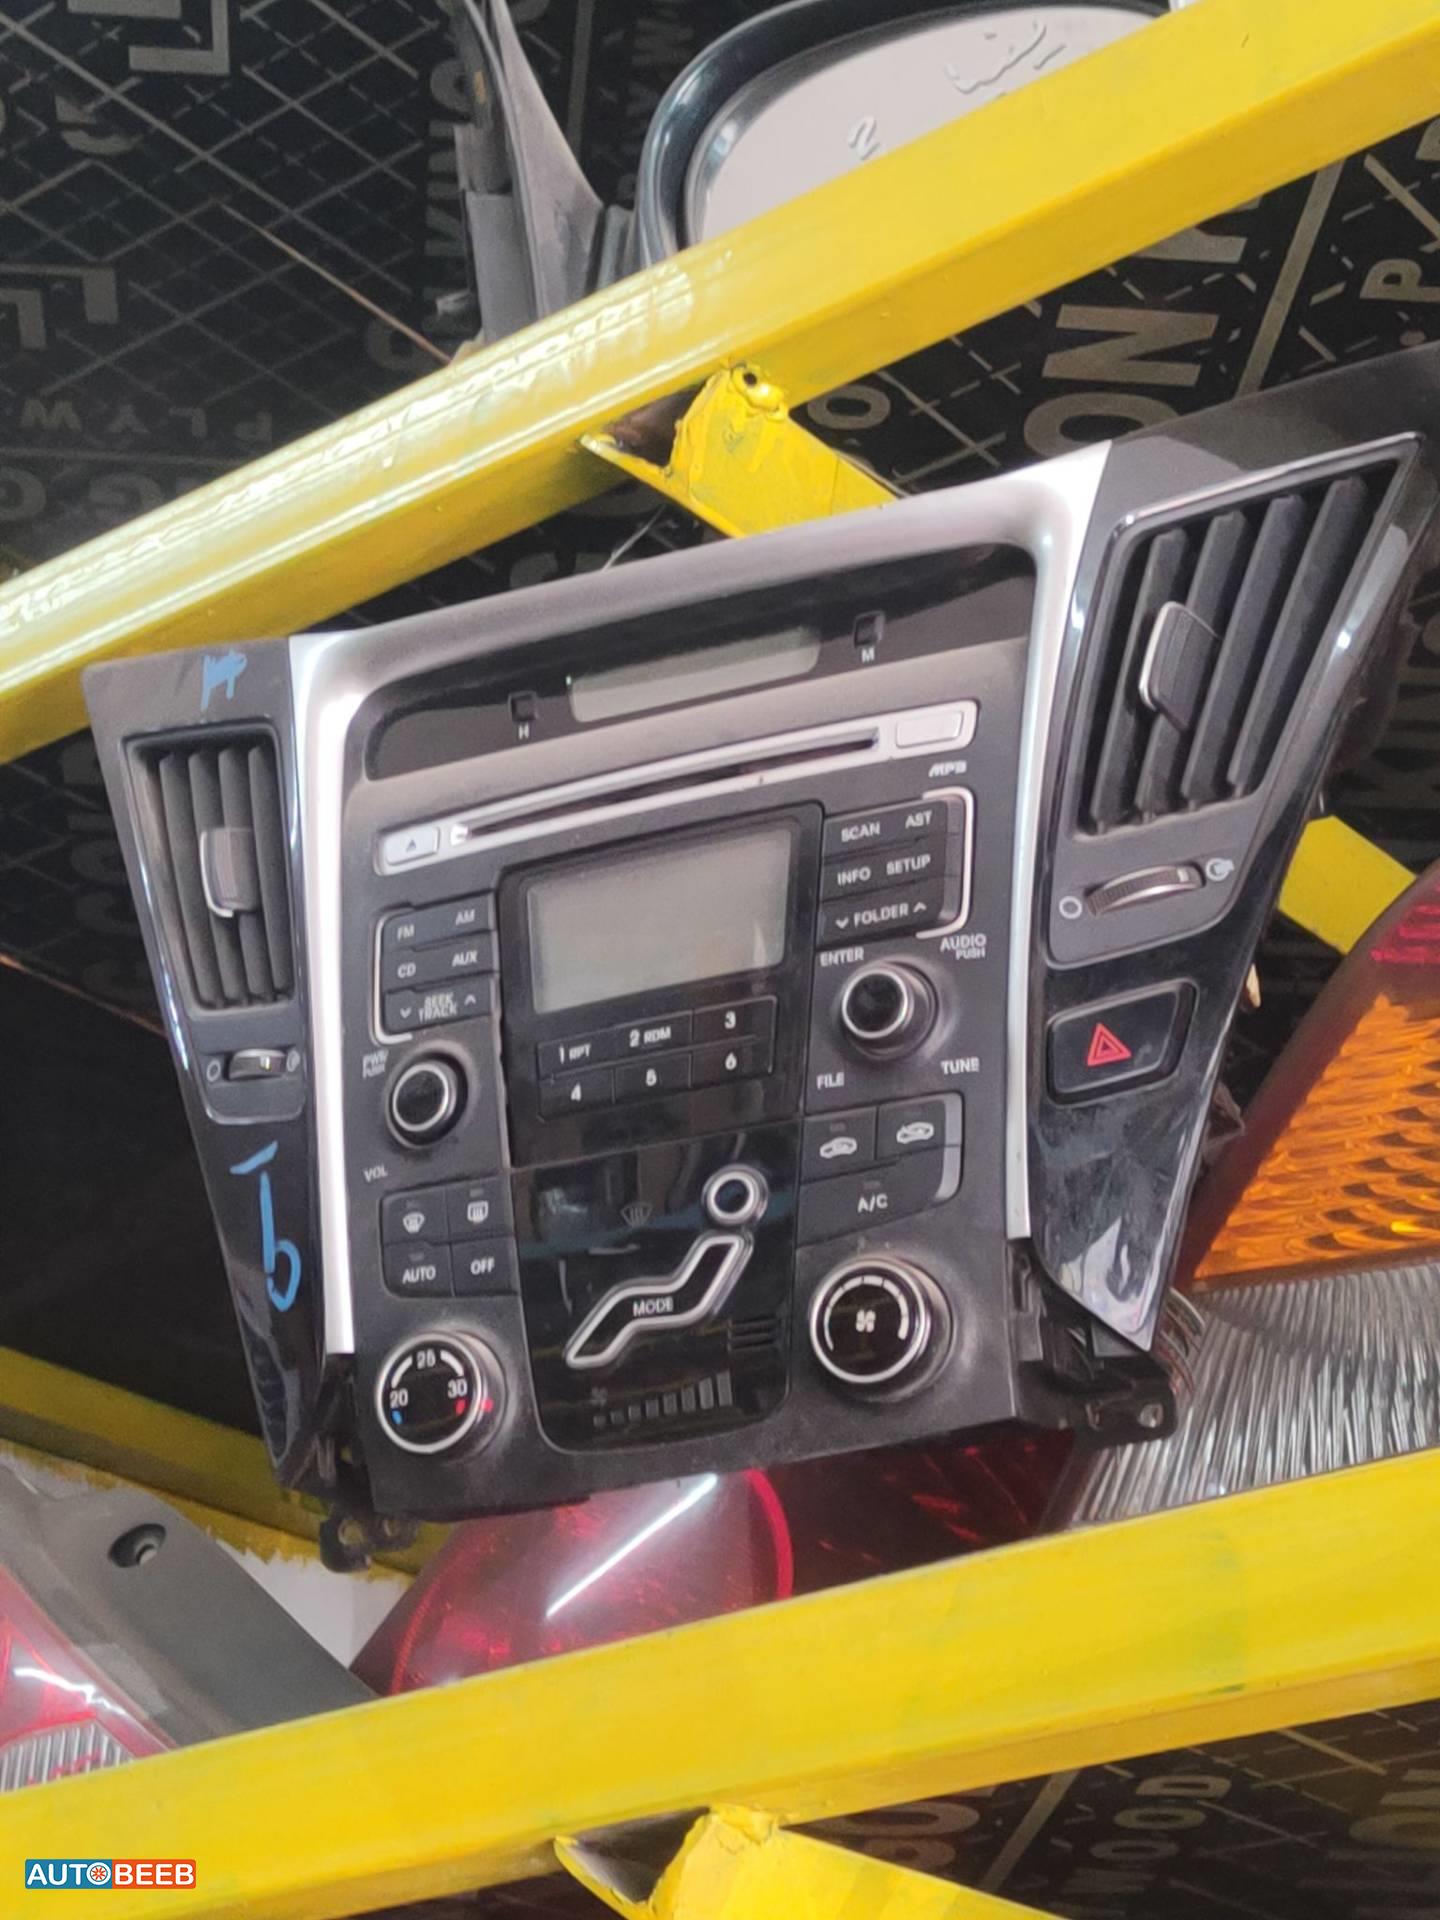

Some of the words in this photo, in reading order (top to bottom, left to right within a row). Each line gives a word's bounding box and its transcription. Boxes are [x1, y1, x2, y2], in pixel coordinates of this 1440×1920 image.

[840, 821, 881, 843] SCAN
[904, 810, 932, 830] AST
[836, 866, 871, 887] INFO
[885, 854, 931, 876] SETUP
[396, 924, 415, 940] FM
[455, 909, 476, 925] AM
[853, 902, 909, 927] FOLDER
[939, 933, 987, 953] AUDIO
[397, 963, 417, 978] CD
[452, 950, 478, 967] AUX
[819, 946, 865, 967] ENTER
[724, 1010, 736, 1029] 3
[628, 1028, 641, 1048] 2
[725, 1052, 737, 1071] 6
[940, 1056, 981, 1075] TUNE
[816, 1071, 846, 1090] FILE
[570, 1081, 582, 1102] 4
[857, 1193, 889, 1213] A/C
[402, 1265, 437, 1284] AUTO
[470, 1257, 496, 1275] OFF
[632, 1296, 674, 1317] MODE
[389, 1389, 409, 1409] 20
[447, 1378, 468, 1399] 30
